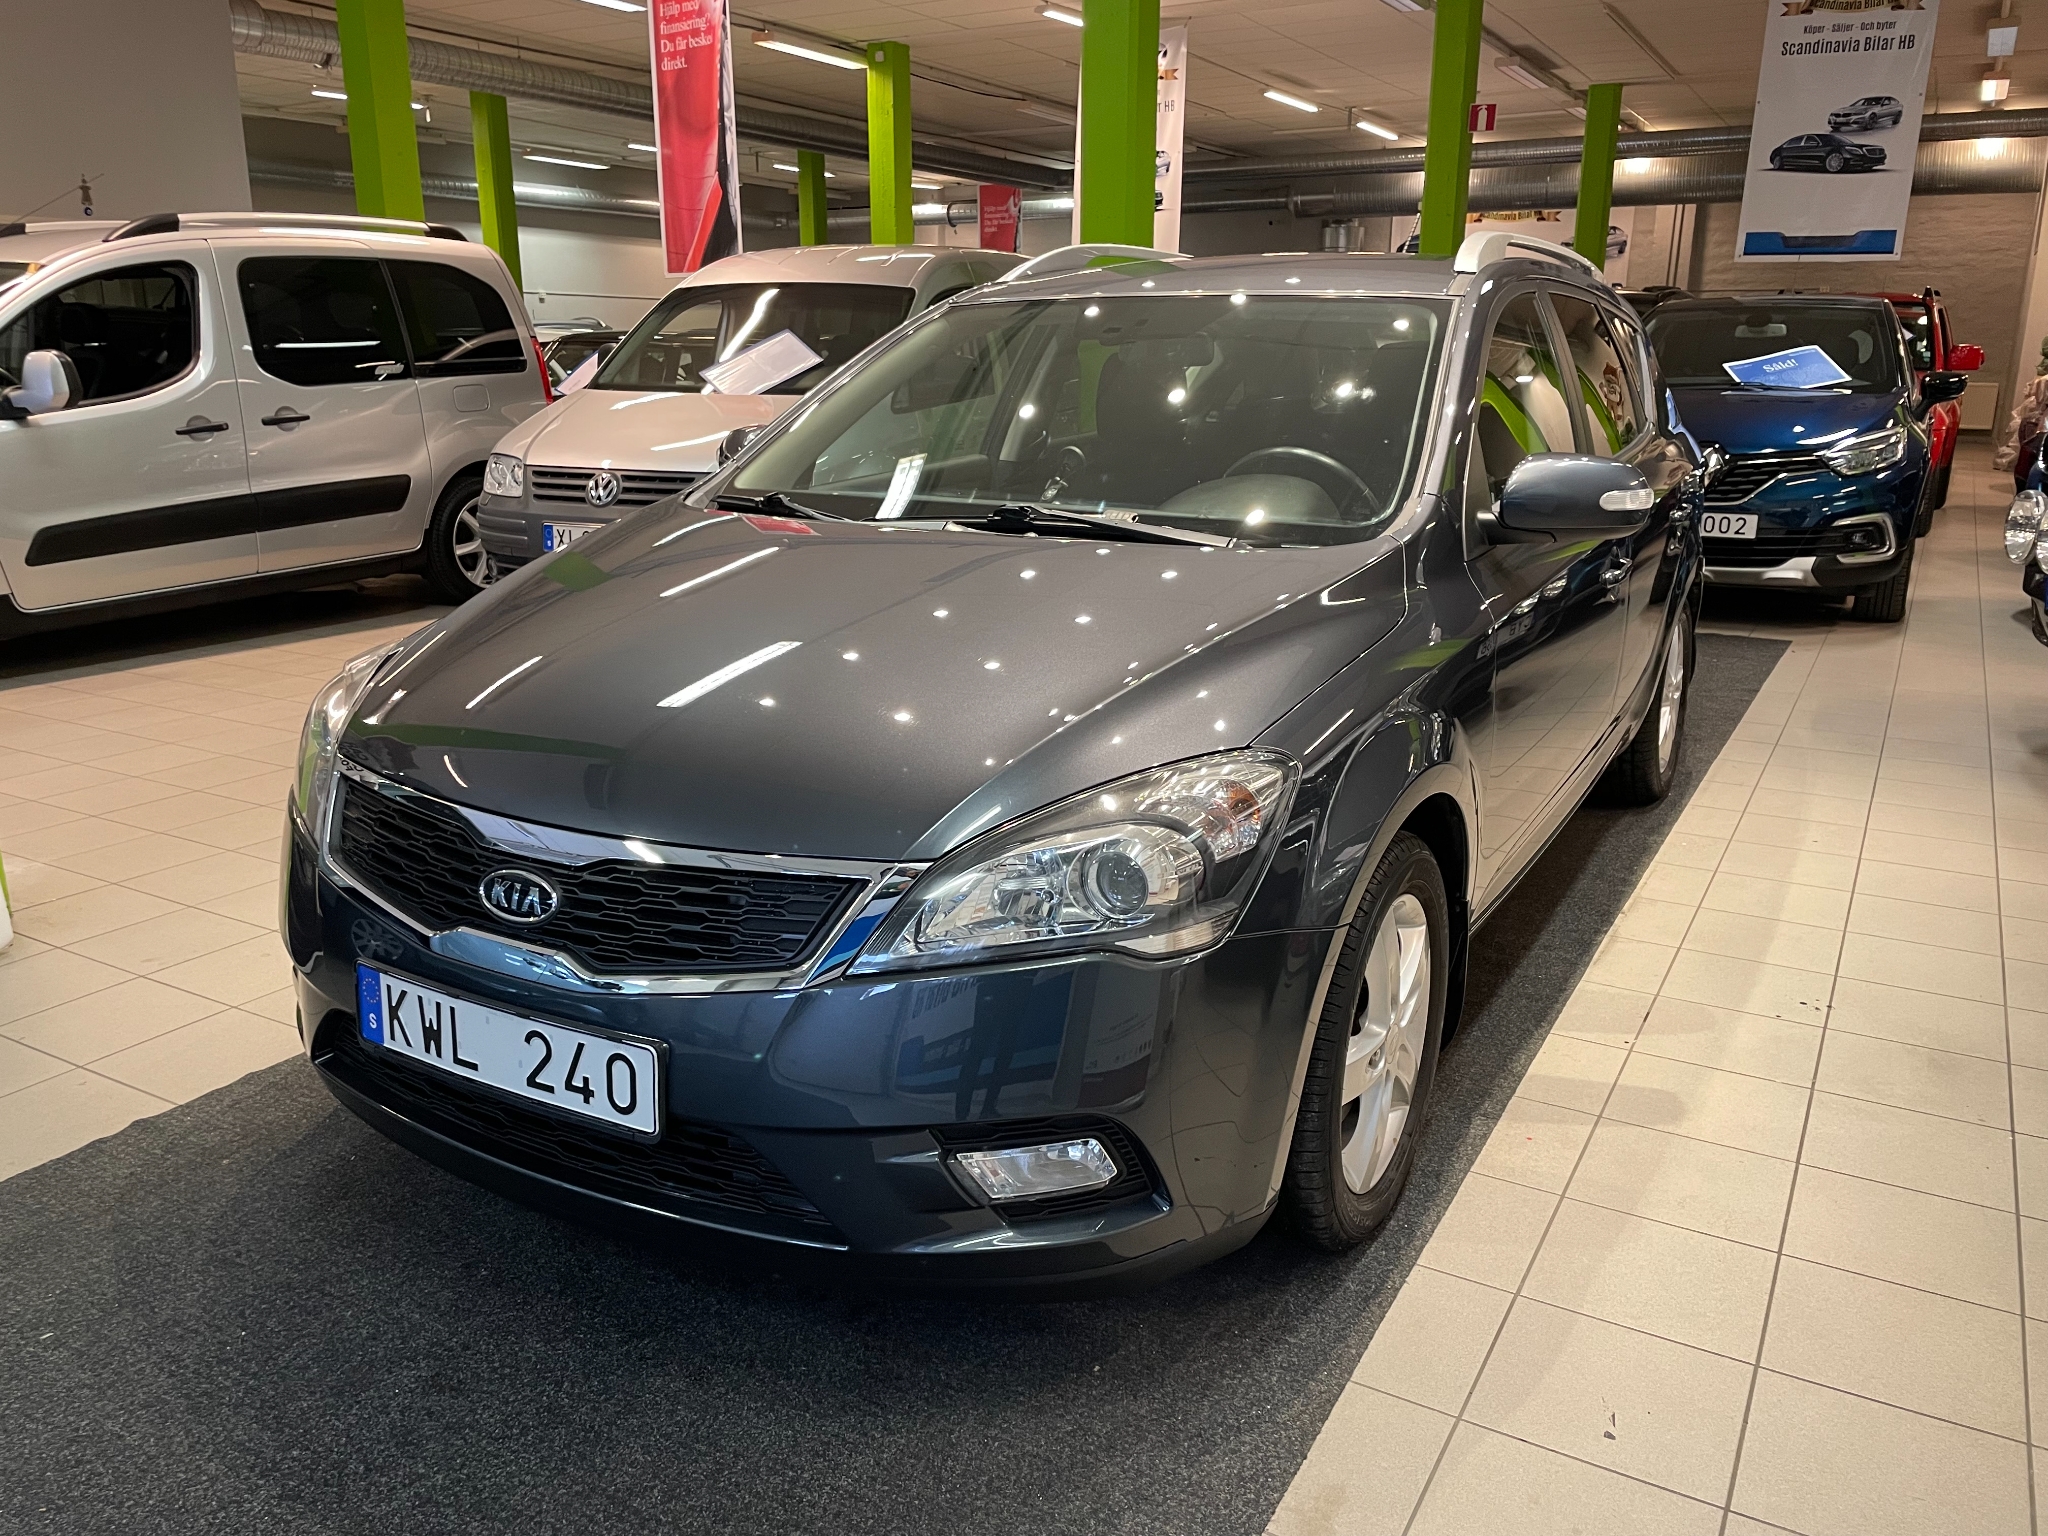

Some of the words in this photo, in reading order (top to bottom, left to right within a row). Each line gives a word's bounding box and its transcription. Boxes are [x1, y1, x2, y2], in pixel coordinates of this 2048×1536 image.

[1803, 25, 1825, 35] Köper
[1832, 22, 1854, 33] Säljer
[1860, 21, 1875, 31] Och
[1876, 20, 1897, 31] byter
[660, 39, 675, 53] Du
[1781, 37, 1861, 56] Scandinavia
[1864, 35, 1895, 52] Bilar
[1898, 34, 1916, 50] HB
[1164, 99, 1175, 113] HB
[1762, 358, 1799, 373] Såld!
[1703, 515, 1747, 535] 002
[491, 877, 542, 916] KIA
[369, 1013, 377, 1029] S
[386, 983, 479, 1072] KWL
[524, 1029, 638, 1116] 240
